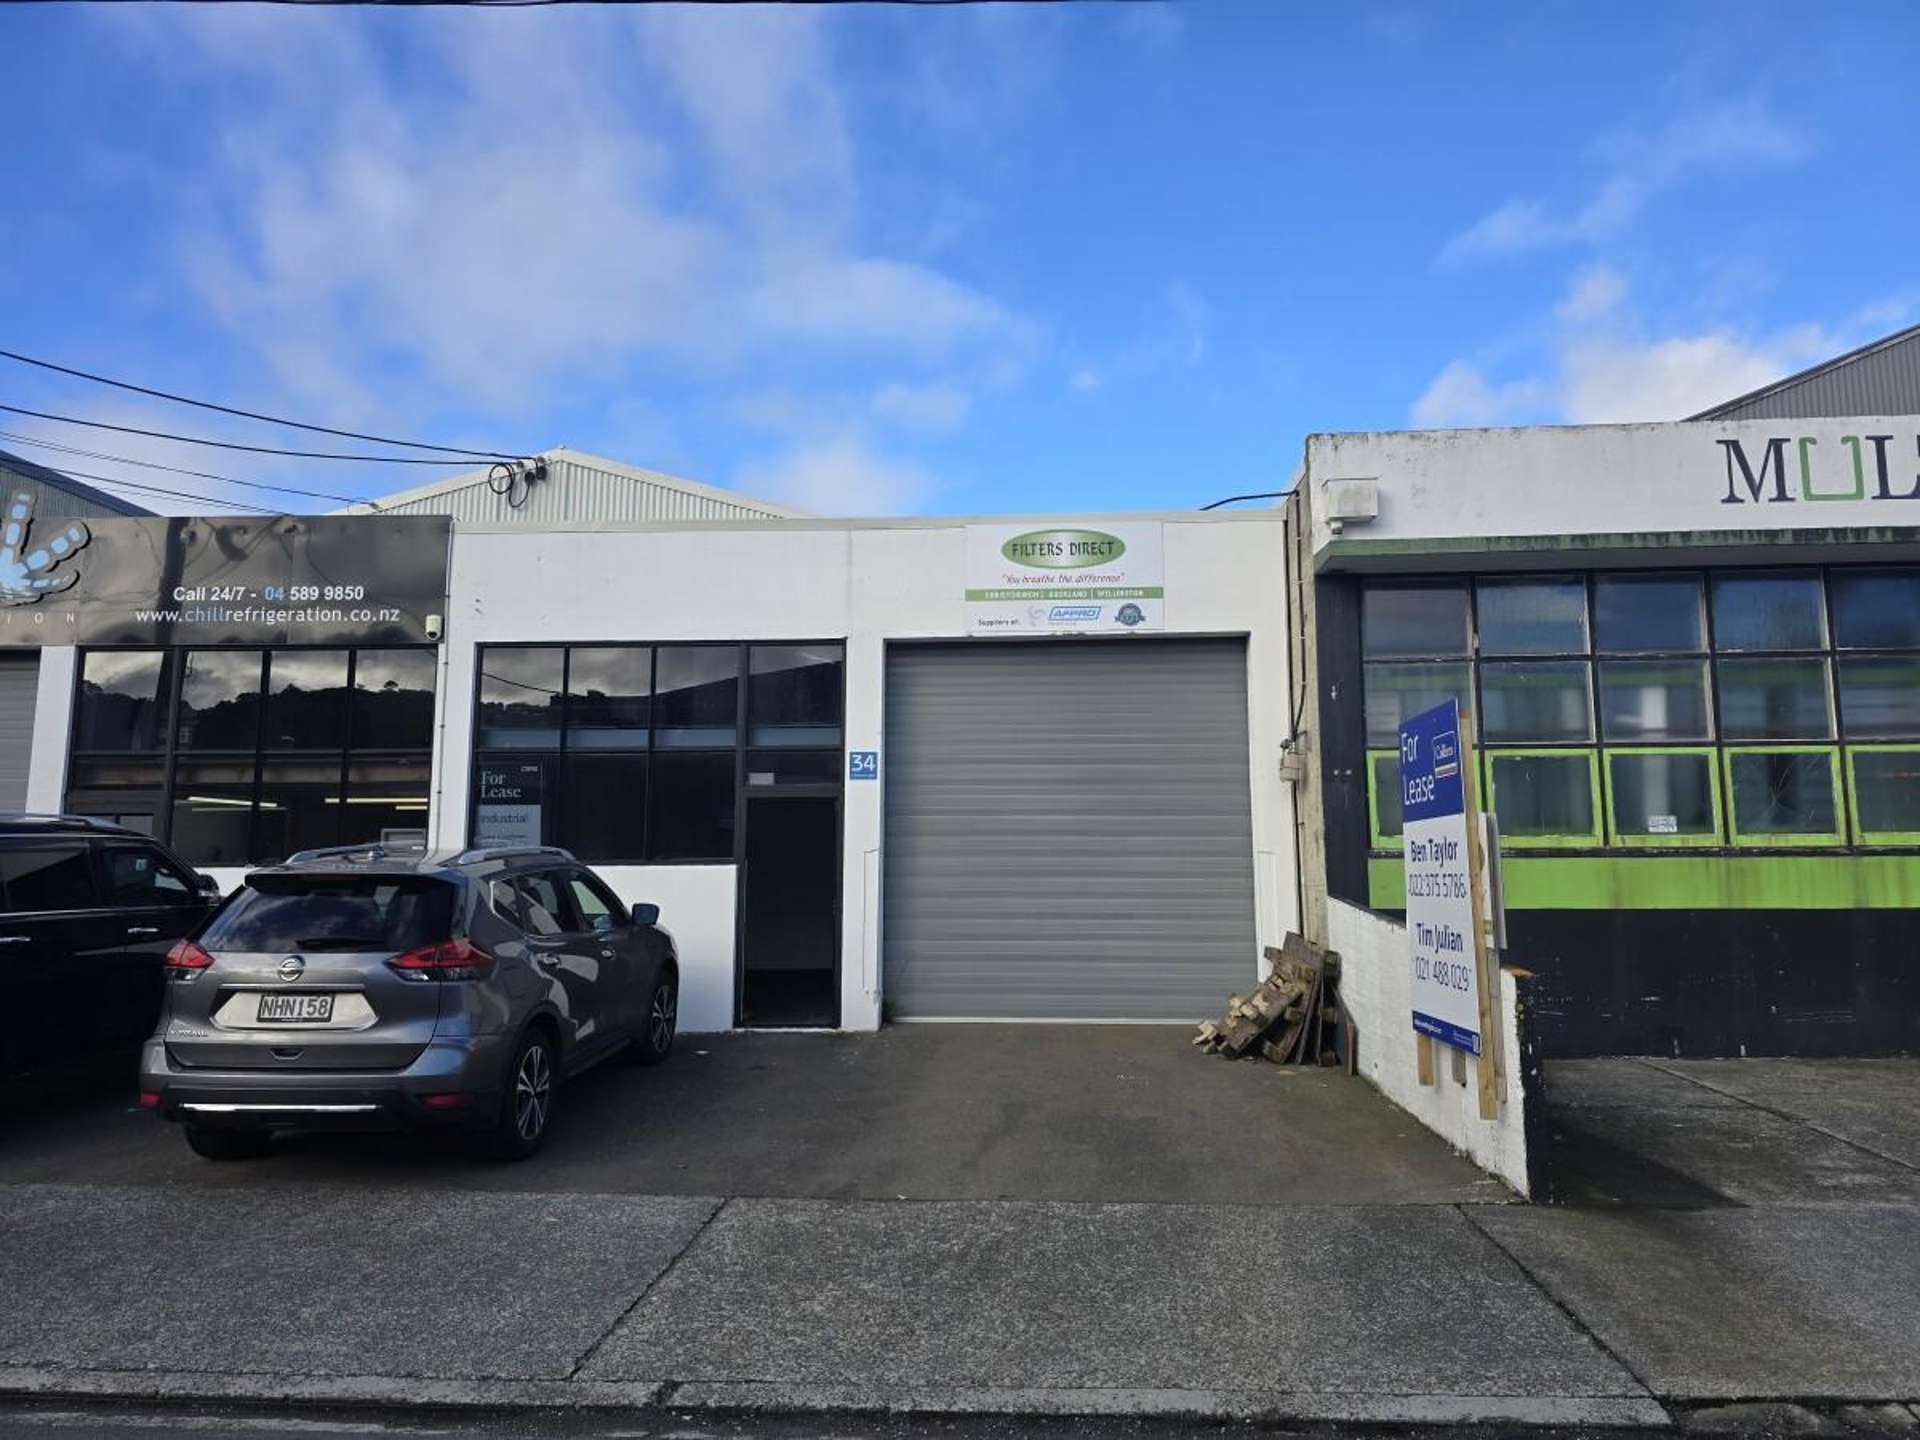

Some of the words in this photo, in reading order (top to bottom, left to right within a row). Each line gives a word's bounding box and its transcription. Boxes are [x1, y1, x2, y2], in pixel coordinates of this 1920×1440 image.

[1715, 434, 1920, 503] MUL
[1011, 541, 1064, 557] FILTERS
[1069, 541, 1115, 556] DIRECT
[1022, 574, 1055, 584] breathe
[1059, 573, 1073, 583] the
[173, 586, 206, 601] Call
[210, 586, 246, 601] 24/7
[264, 586, 285, 600] 04
[290, 586, 319, 601] 589
[323, 586, 365, 600] 9850
[135, 606, 400, 625] www.chillrefrigeration.co.nz
[1401, 732, 1420, 764] For
[851, 754, 876, 772] 34
[481, 770, 507, 785] For
[481, 785, 522, 798] Lease
[1403, 774, 1435, 806] Lease
[1410, 840, 1427, 863] Ben
[1428, 836, 1459, 868] Taylor
[1409, 874, 1425, 897] 022
[1426, 874, 1441, 897] 375
[1416, 921, 1434, 948] Tim
[1434, 924, 1463, 954] Julian
[1415, 956, 1430, 980] 021
[1450, 964, 1469, 992] 029
[261, 995, 329, 1019] NHN158
